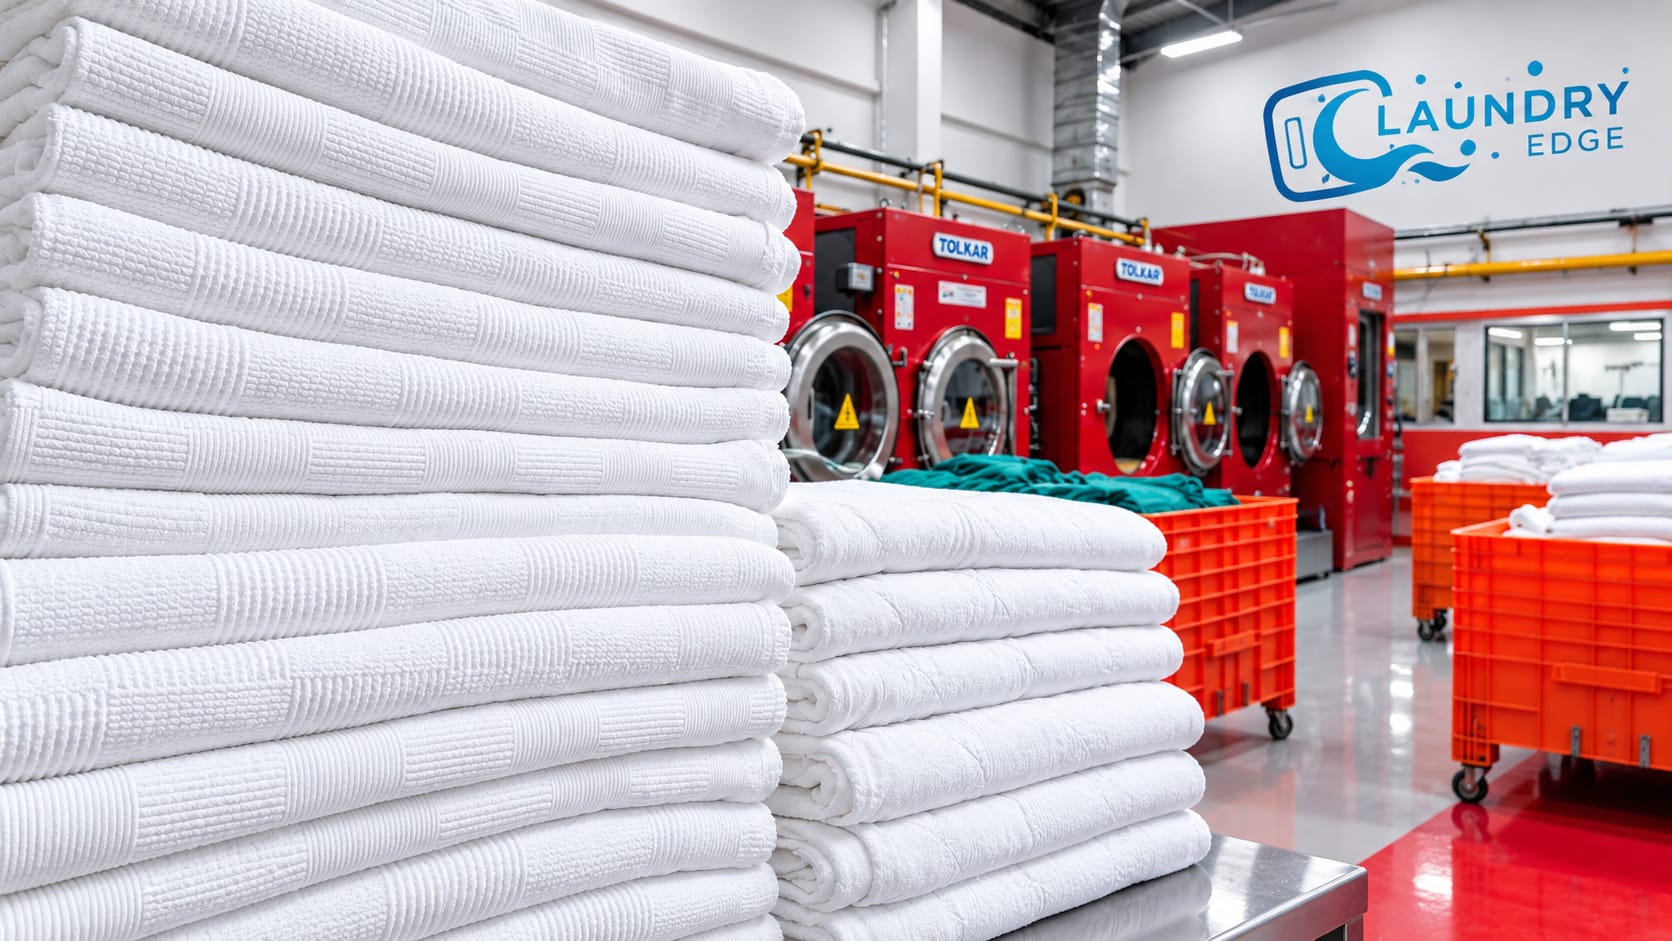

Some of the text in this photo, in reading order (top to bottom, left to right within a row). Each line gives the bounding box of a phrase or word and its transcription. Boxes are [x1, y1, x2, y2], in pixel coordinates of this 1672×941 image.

[1377, 80, 1630, 137] LAUNDRY
[1527, 126, 1624, 157] EDGE
[938, 237, 989, 260] TOLKAR
[1120, 261, 1160, 281] TOLKAR
